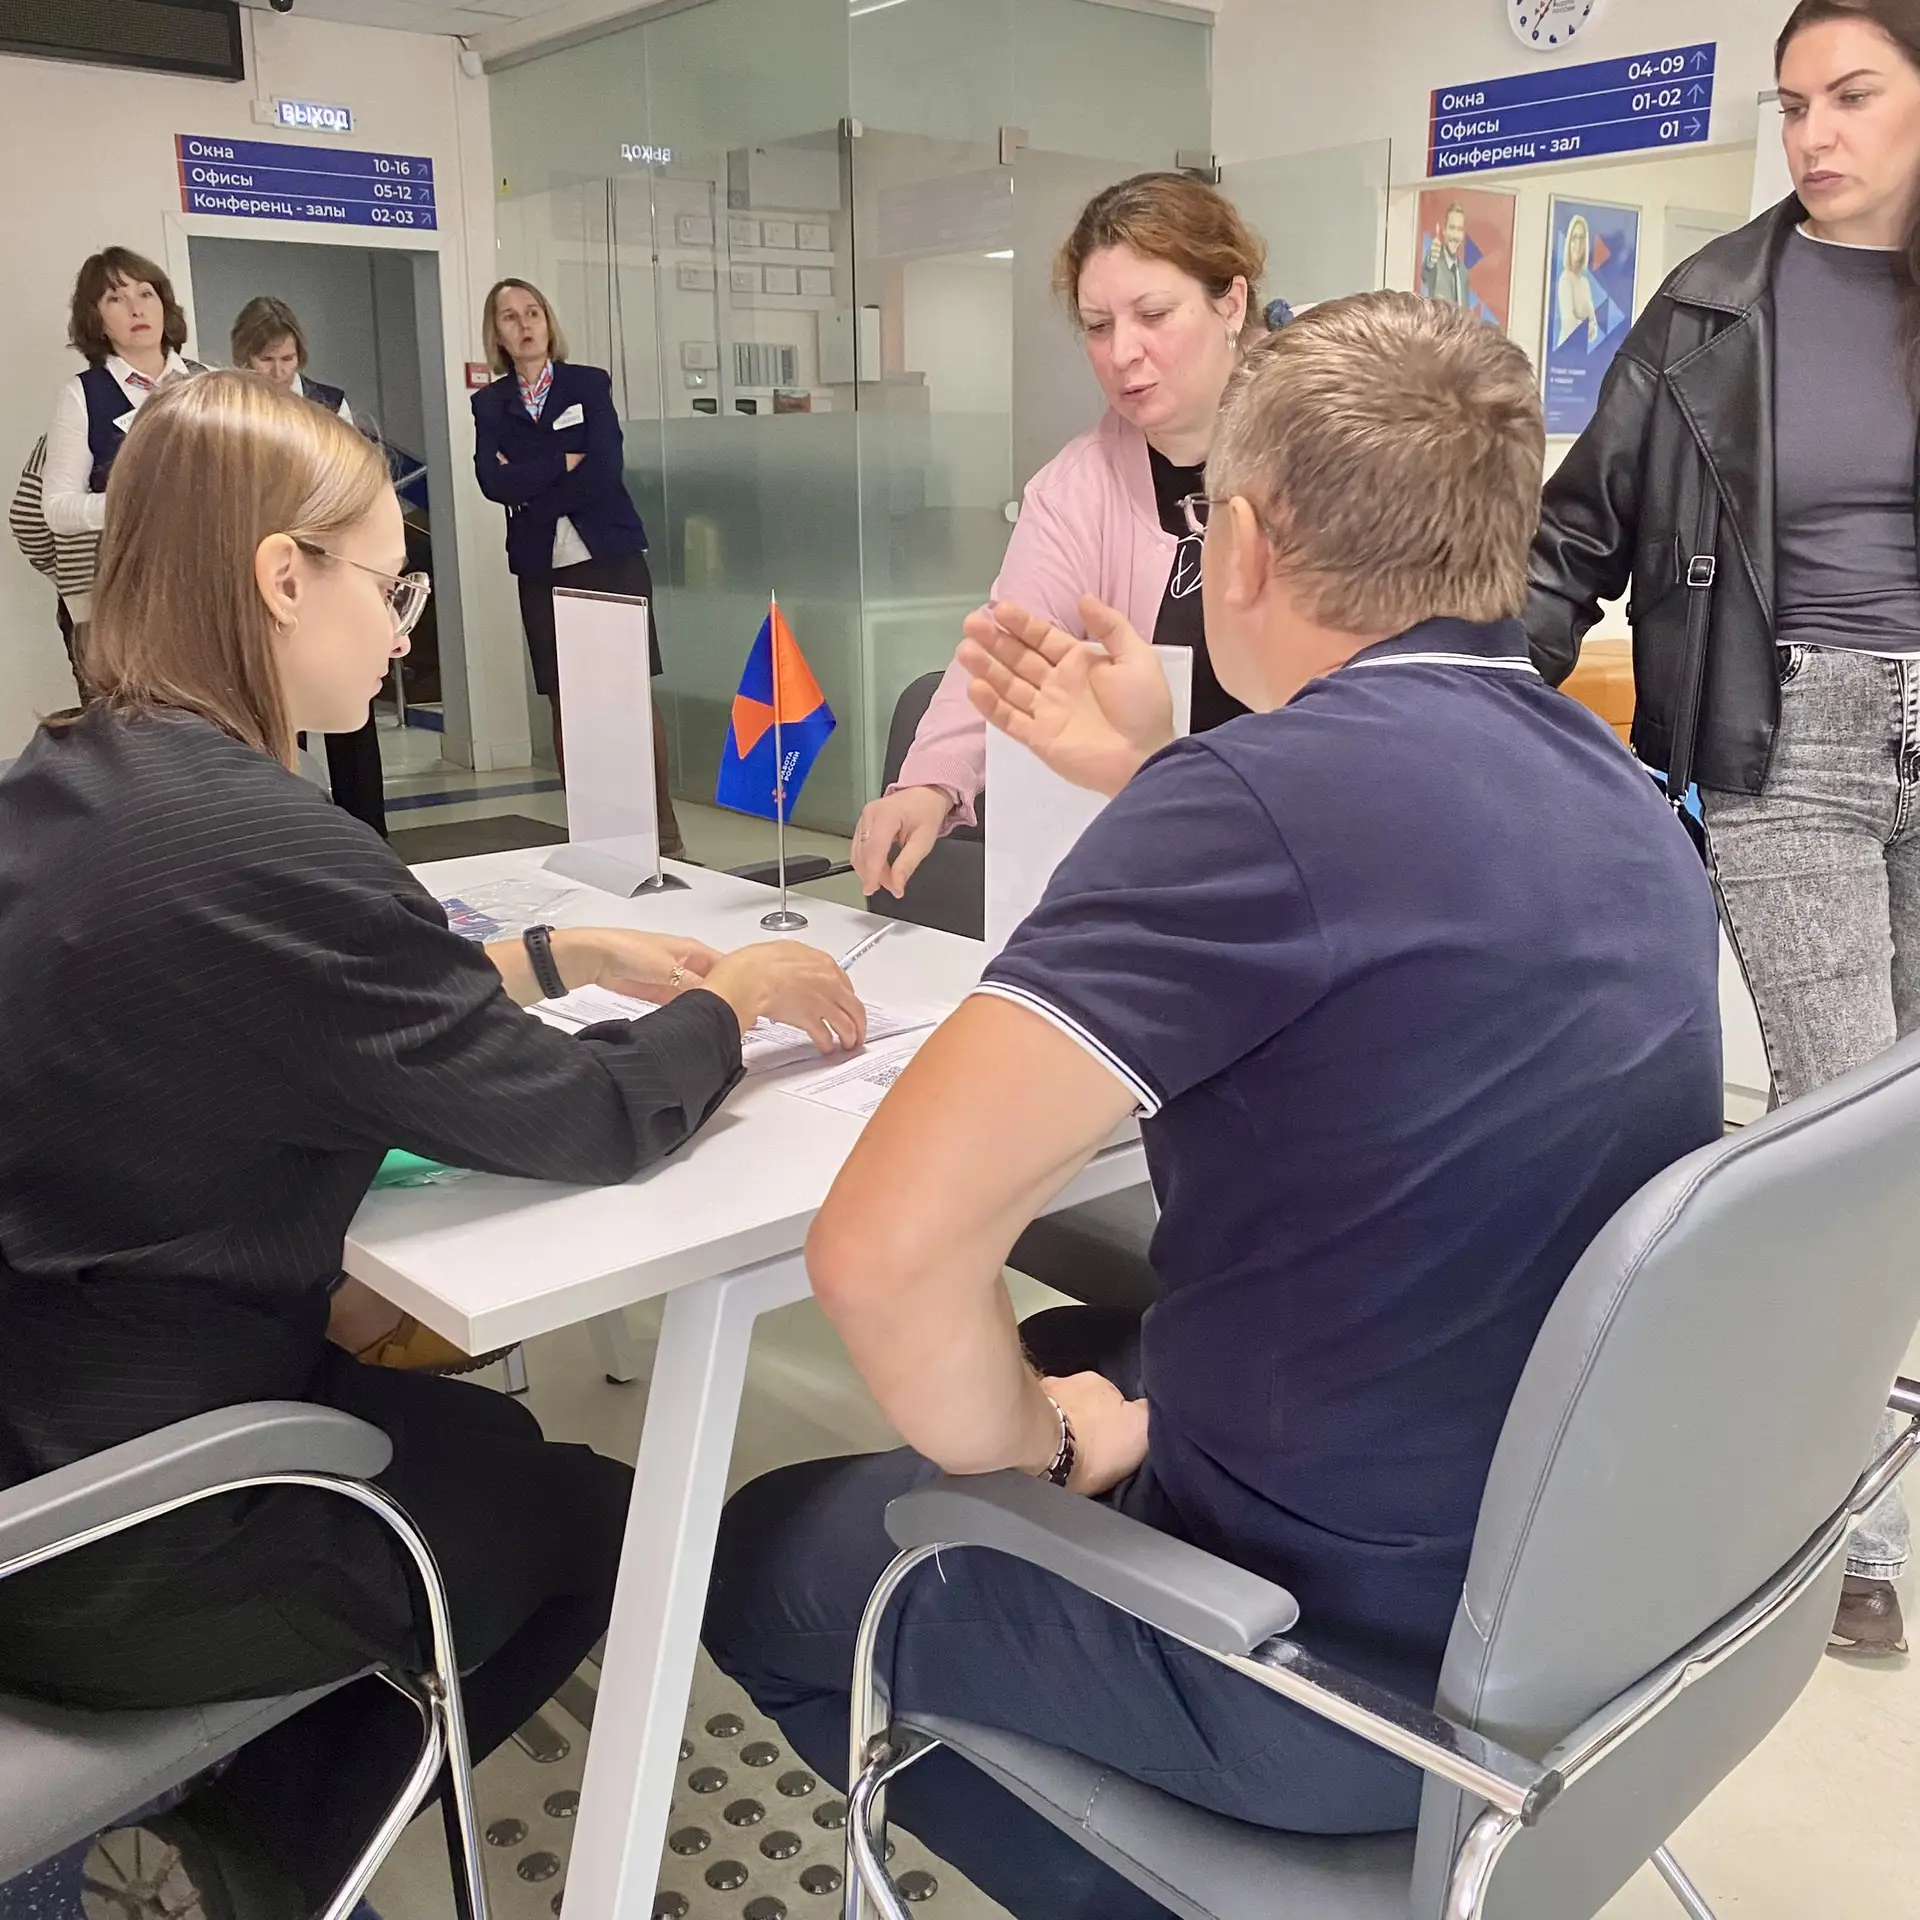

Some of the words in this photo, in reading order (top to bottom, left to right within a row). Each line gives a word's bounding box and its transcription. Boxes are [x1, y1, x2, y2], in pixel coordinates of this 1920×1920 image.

[1441, 91, 1485, 111] Окна
[1628, 55, 1685, 81] 04-09
[282, 103, 349, 131] ВЫХОД
[1440, 118, 1500, 140] Офисы
[1632, 88, 1682, 112] 01-02
[189, 141, 235, 159] Окна
[373, 159, 411, 175] 10-16
[1438, 144, 1536, 169] Конференц
[1550, 136, 1581, 152] зал
[1659, 121, 1680, 139] 01
[192, 168, 254, 186] Офисы
[373, 184, 412, 200] 05-12
[193, 193, 293, 216] Конференц
[306, 204, 346, 218] залы
[371, 208, 414, 224] 02-03
